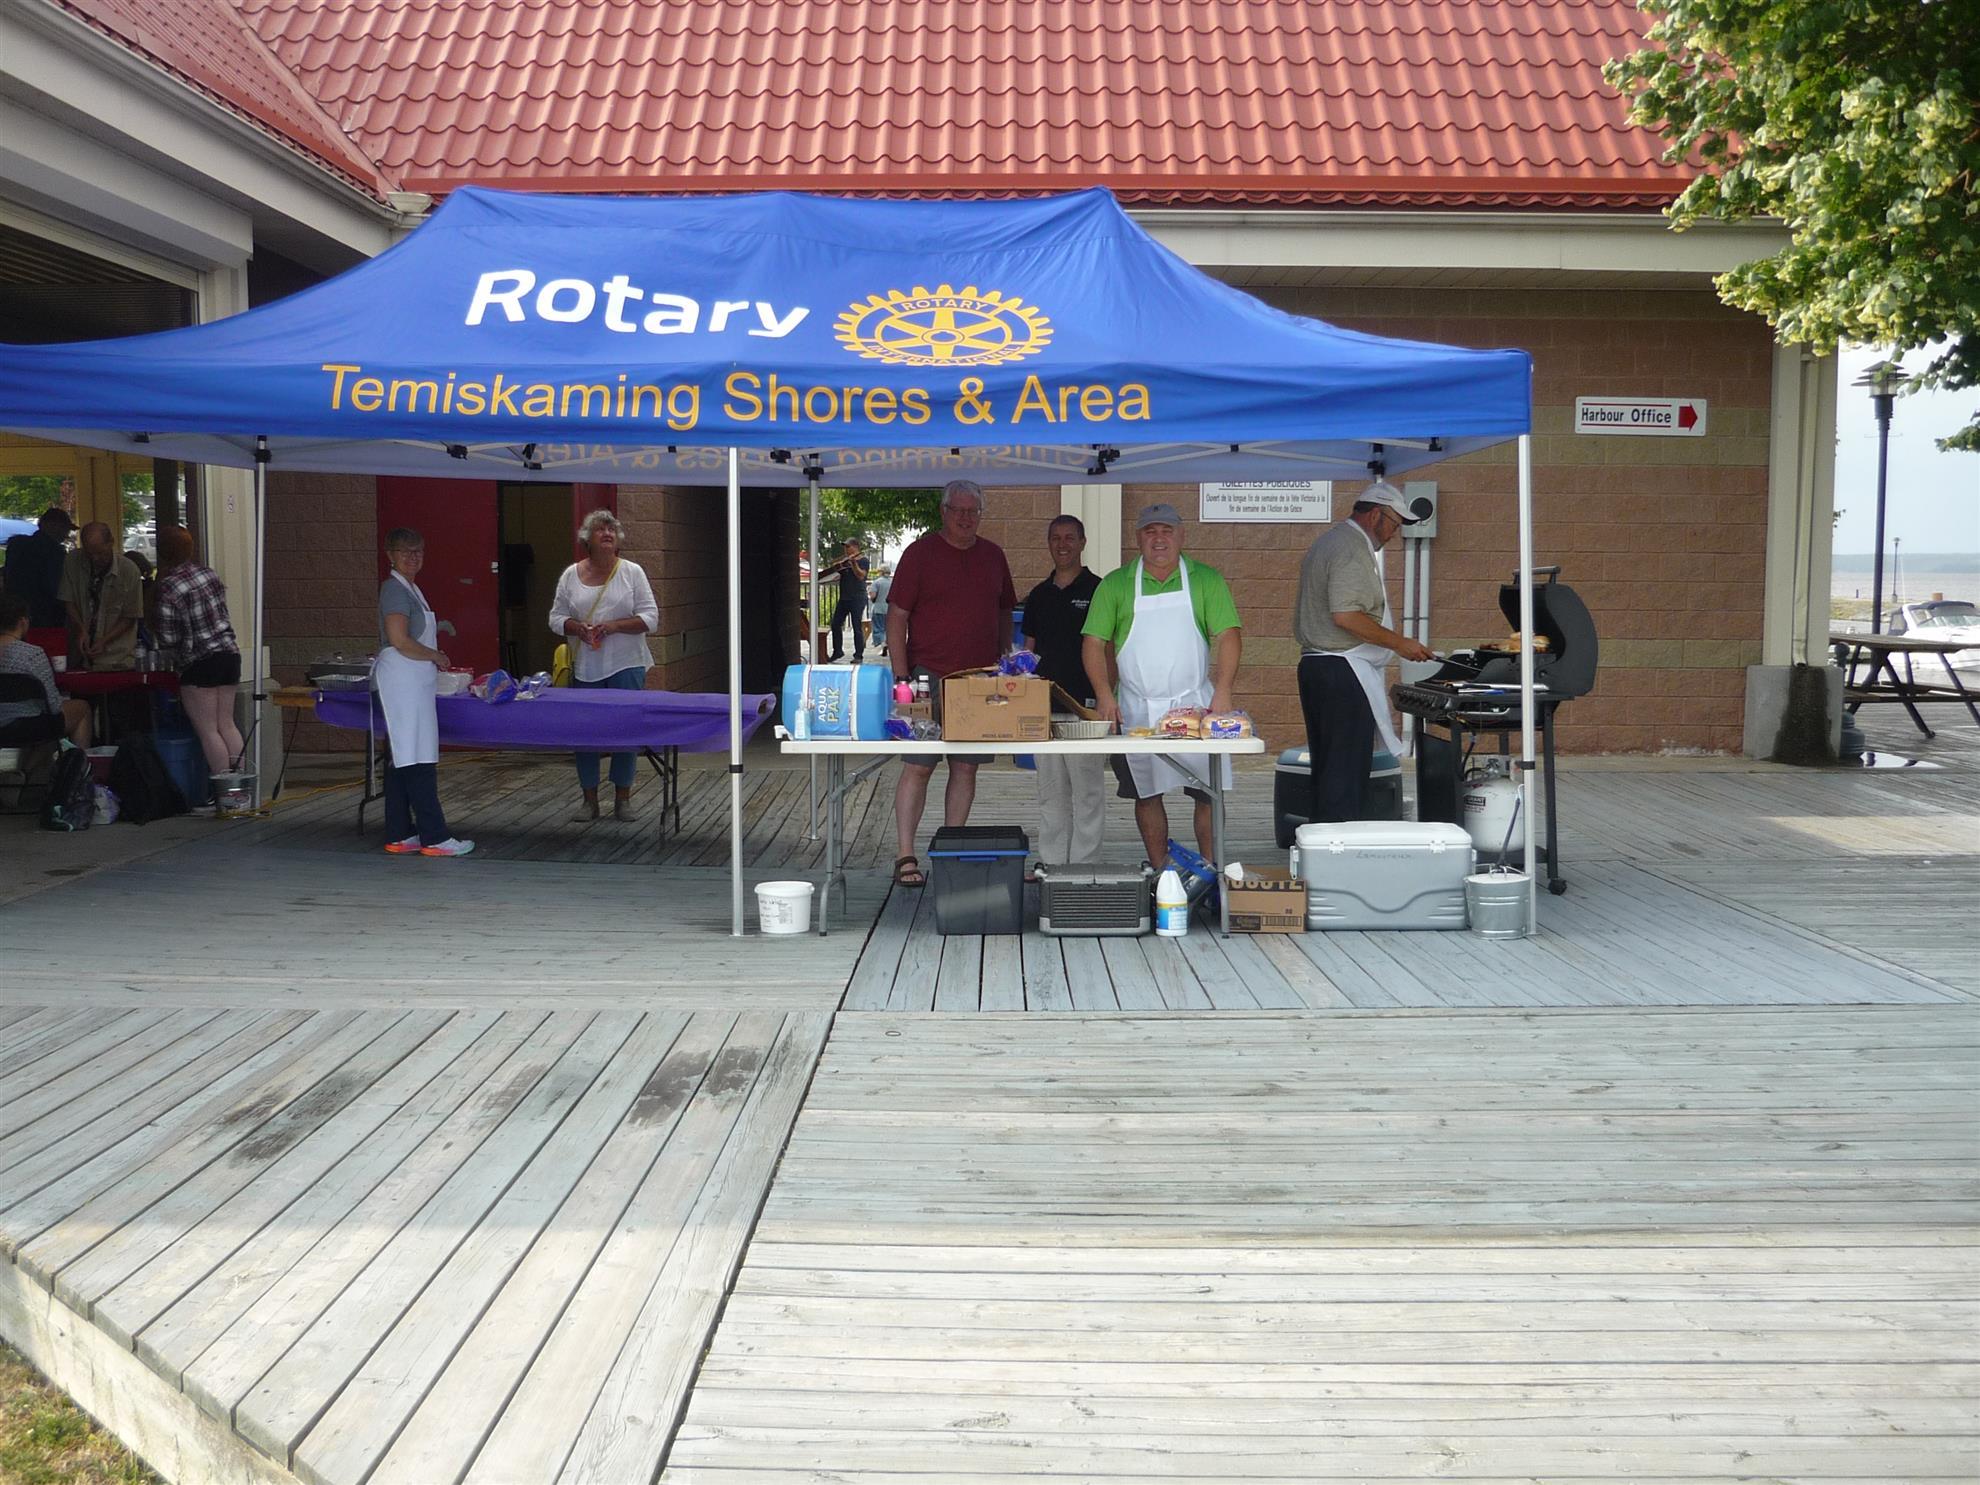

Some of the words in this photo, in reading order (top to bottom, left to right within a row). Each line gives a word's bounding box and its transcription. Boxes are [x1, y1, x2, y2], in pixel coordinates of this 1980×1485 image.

[464, 269, 810, 338] Rotary
[900, 298, 988, 311] ROTARY
[866, 343, 1022, 365] INTERNATIONAL
[321, 363, 701, 431] Temiskaming
[722, 371, 931, 425] Shores
[953, 376, 995, 425] &
[1010, 374, 1152, 424] Area
[1581, 407, 1624, 422] Harbour
[1631, 408, 1672, 423] Office
[817, 687, 828, 722] AQUA
[827, 687, 840, 723] PAK
